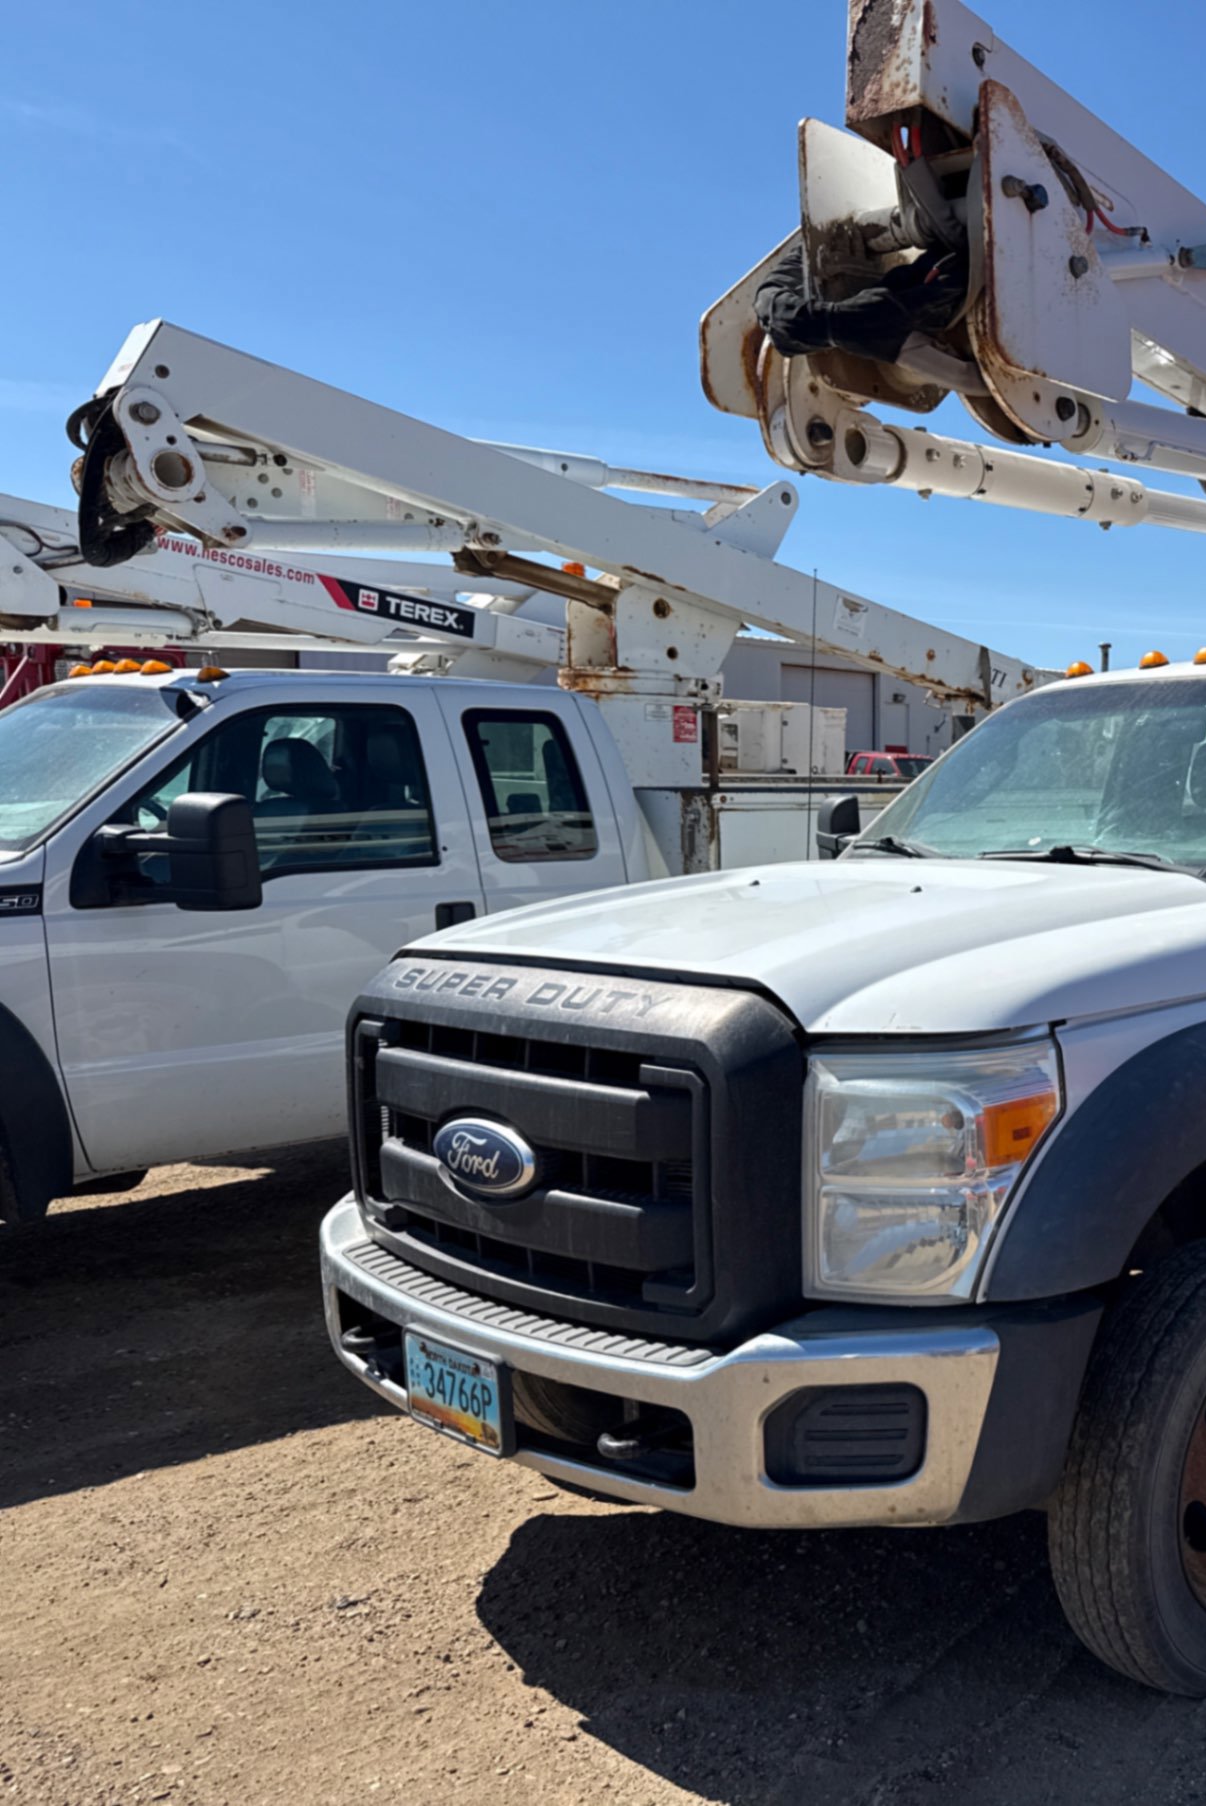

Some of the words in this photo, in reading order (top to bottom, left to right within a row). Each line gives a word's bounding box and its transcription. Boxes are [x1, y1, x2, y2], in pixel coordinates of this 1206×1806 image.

[156, 536, 315, 585] www.nescosales.com
[385, 596, 459, 630] TEREX
[394, 967, 519, 1000] SUPER
[525, 981, 674, 1017] DUTY
[447, 1131, 500, 1179] Ford
[424, 1362, 493, 1420] 34766P
